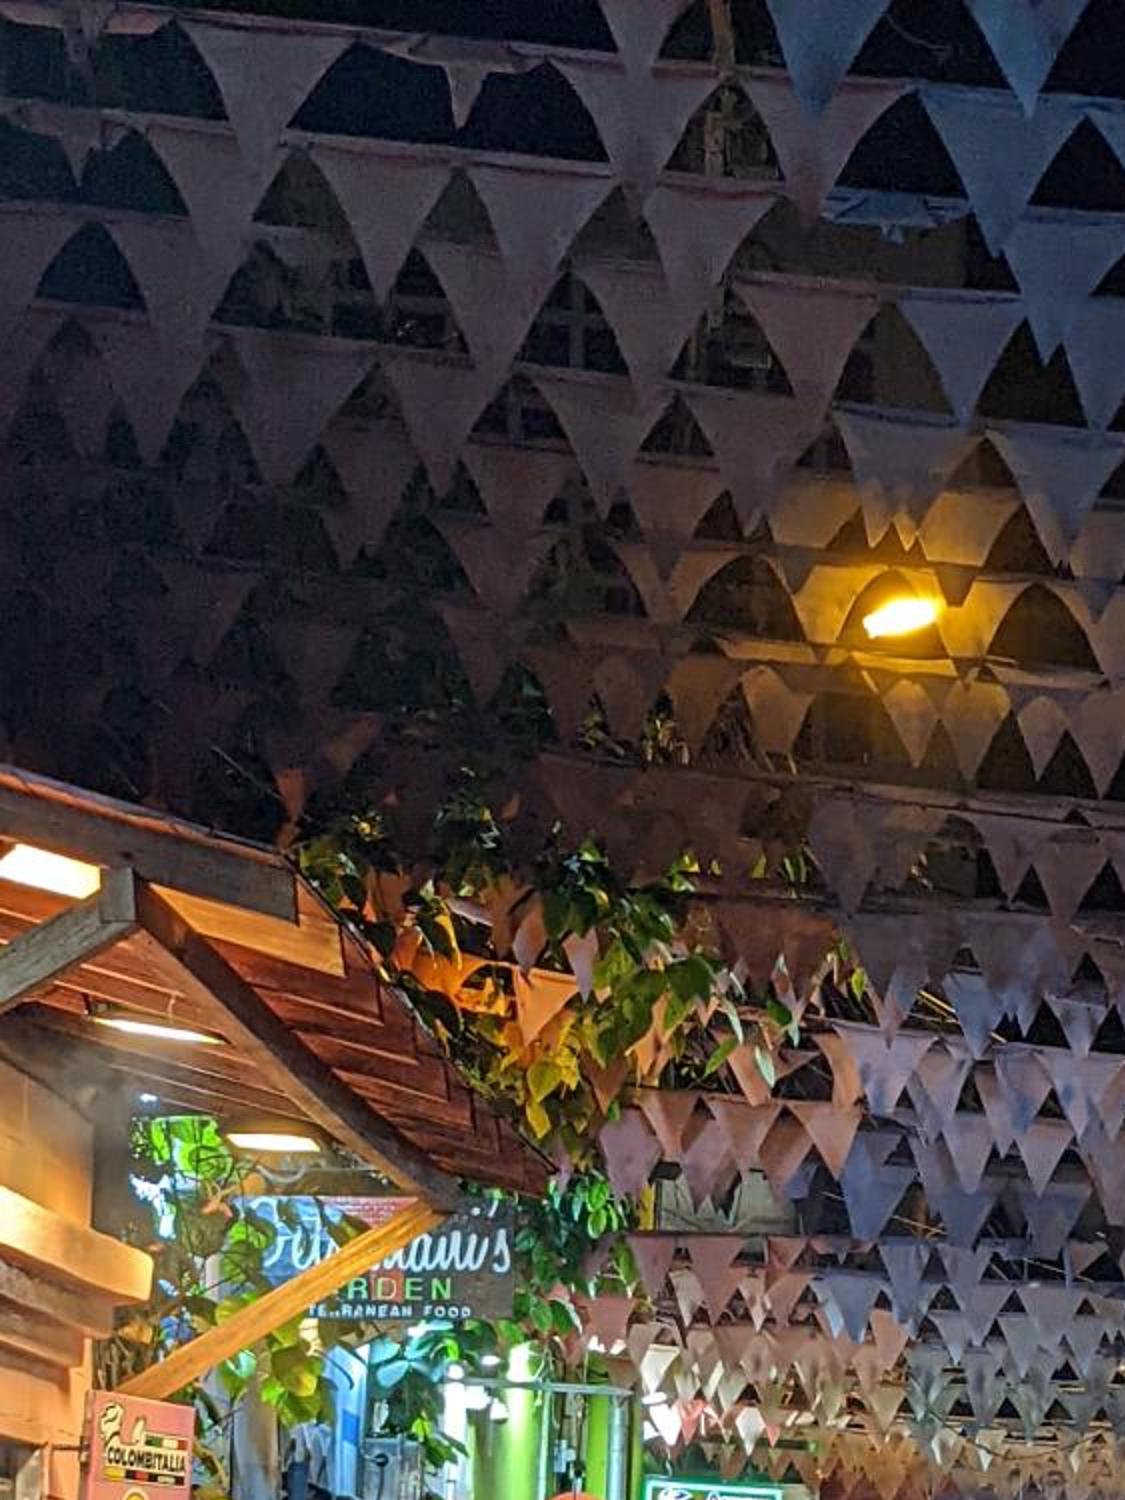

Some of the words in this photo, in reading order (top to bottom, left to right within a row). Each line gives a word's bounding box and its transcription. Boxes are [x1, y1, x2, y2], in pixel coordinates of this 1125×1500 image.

[347, 1277, 452, 1300] RDEN
[423, 1304, 472, 1318] FOOD
[106, 1445, 186, 1473] COLOMBITALIA
